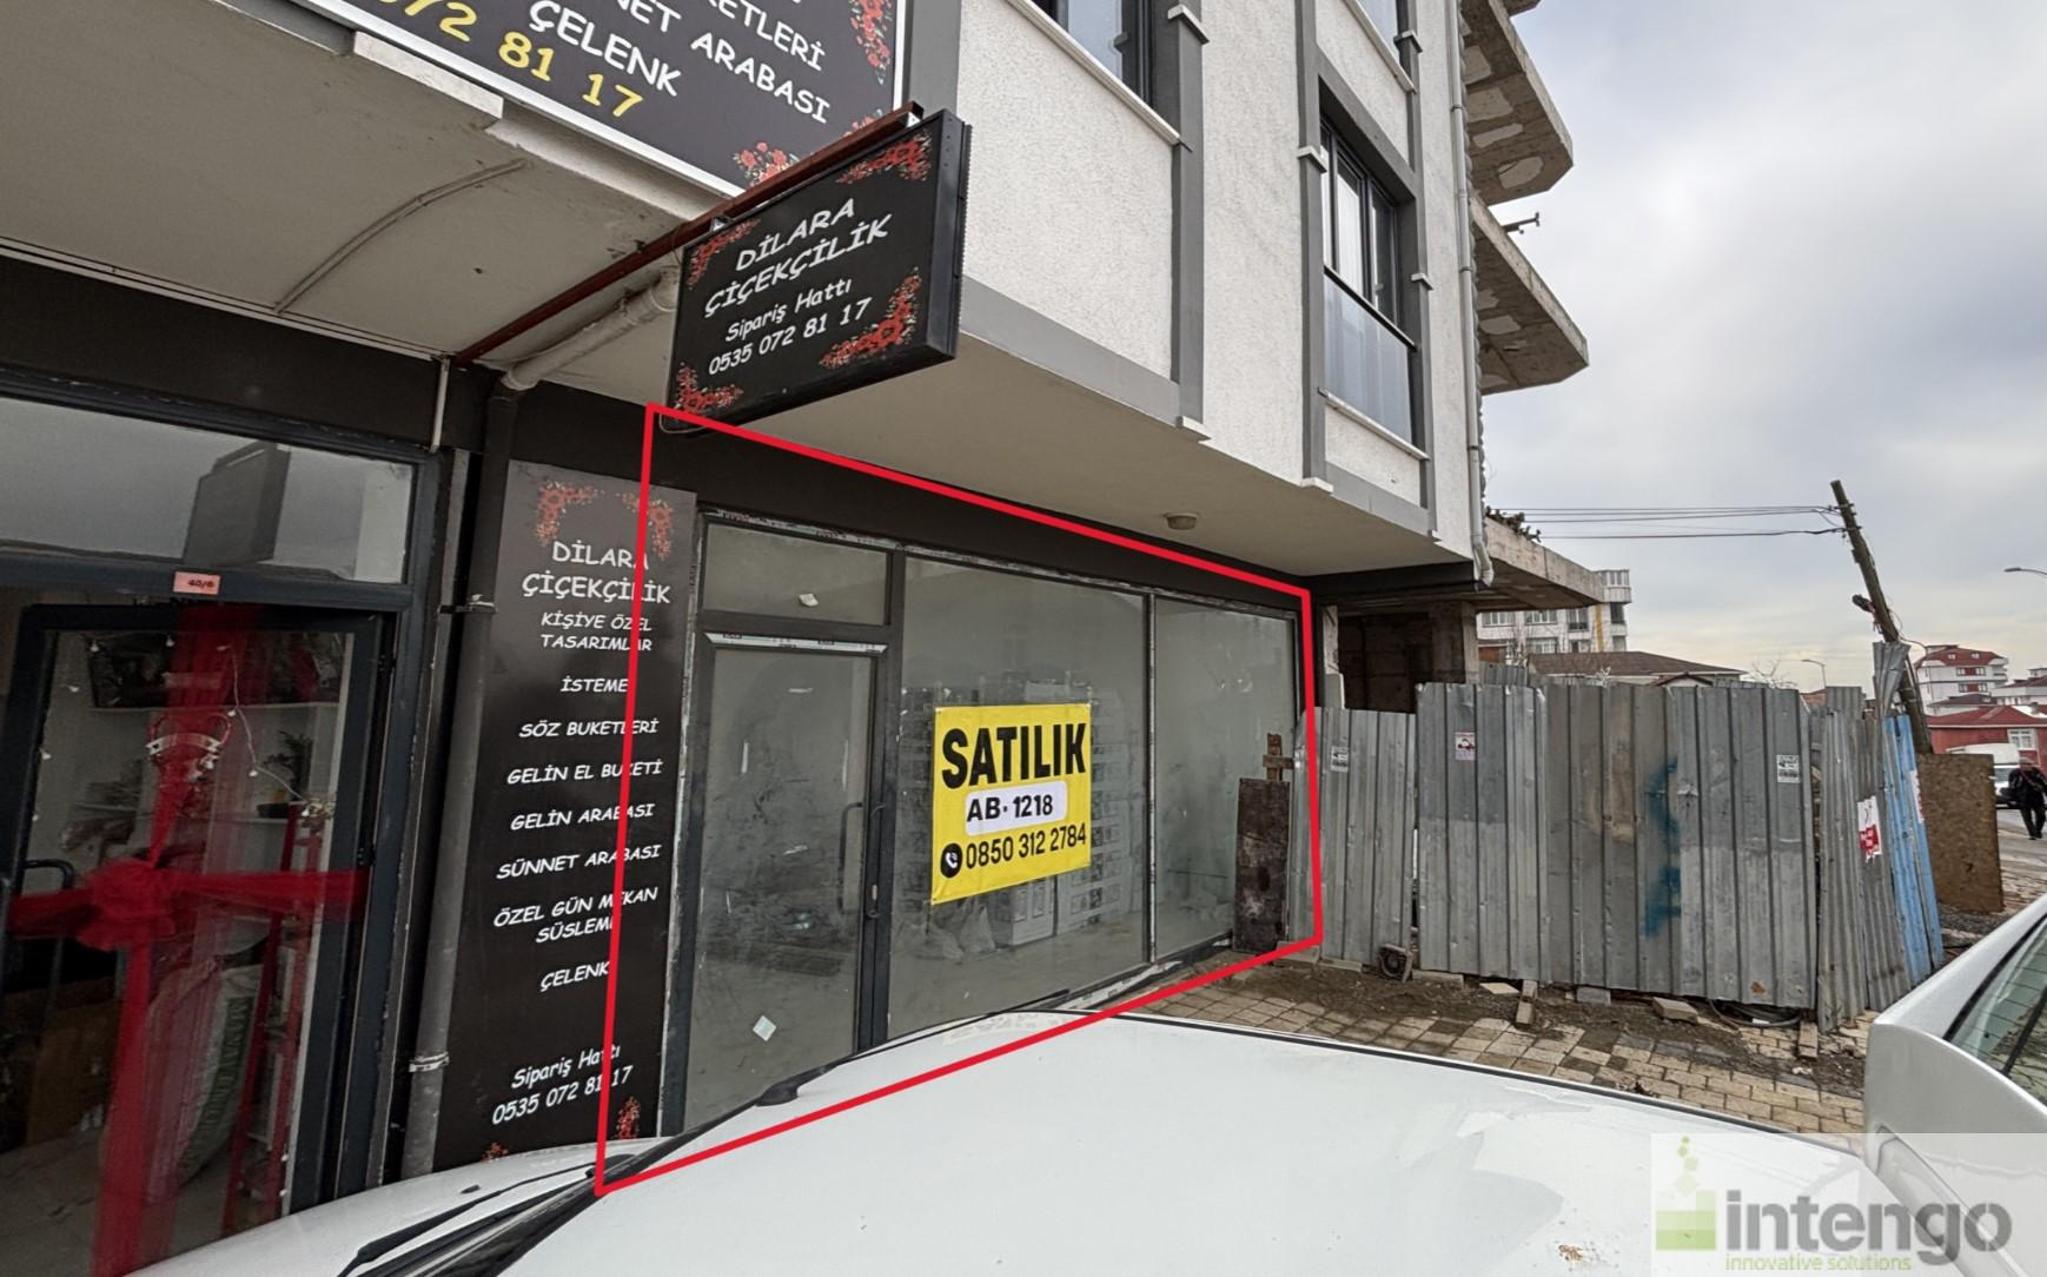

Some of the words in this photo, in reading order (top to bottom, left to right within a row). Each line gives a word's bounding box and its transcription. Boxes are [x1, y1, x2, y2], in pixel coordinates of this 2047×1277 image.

[529, 0, 681, 97] ÇELENK
[708, 0, 826, 71] ETLERİ
[499, 31, 554, 81] 81
[582, 73, 644, 117] 17
[690, 32, 830, 124] ARABASI
[735, 198, 855, 271] DİLARA
[704, 214, 892, 318] ÇİÇEKÇİLİK
[708, 342, 753, 375] 0535
[758, 325, 796, 355] 072
[803, 313, 828, 339] 81
[839, 296, 872, 326] 17
[725, 303, 787, 342] Sipariş
[794, 279, 852, 314] Hattı
[541, 609, 606, 630] KİŞİYE
[560, 675, 629, 692] İSTEME
[519, 720, 562, 738] SÖZ
[507, 764, 569, 785] GELİN
[574, 765, 594, 780] EL
[601, 759, 664, 778] BUETİ
[942, 723, 1086, 789] SATILIK
[510, 809, 572, 831] GELİN
[966, 836, 1014, 869] 0850
[1018, 830, 1046, 858] 312
[1050, 823, 1086, 852] 2784
[496, 854, 580, 880] SÜNNET
[493, 905, 544, 928] ÖZEL
[551, 897, 593, 918] GÜN
[598, 887, 658, 910] MKAN
[540, 961, 611, 993] ÇELENK
[491, 1093, 541, 1125] 0535
[546, 1082, 580, 1108] 072
[584, 1073, 604, 1096] 81
[611, 1065, 633, 1087] 17
[511, 1056, 573, 1090] Sipariş
